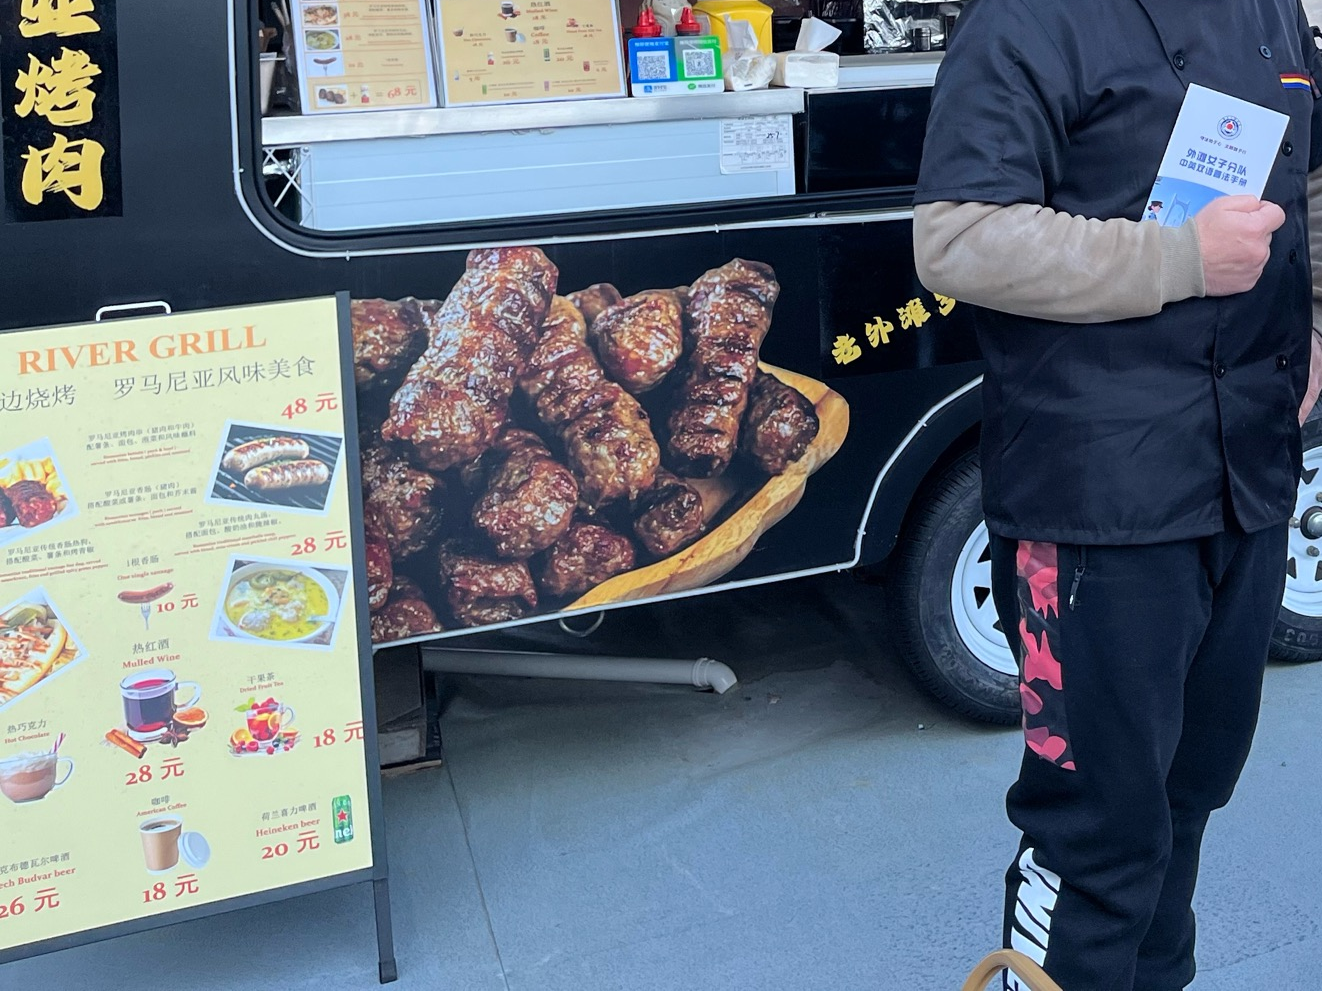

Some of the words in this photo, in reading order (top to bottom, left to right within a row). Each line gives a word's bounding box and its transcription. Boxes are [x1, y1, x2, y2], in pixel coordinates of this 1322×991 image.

[387, 87, 402, 99] 68
[404, 86, 417, 96] 元
[17, 338, 139, 375] RIVER
[149, 325, 267, 360] GRILL
[113, 355, 316, 400] 罗马尼亚风味美食
[281, 397, 308, 420] 48
[315, 391, 338, 412] 元
[291, 536, 317, 556] 28
[324, 530, 347, 551] 元
[157, 603, 175, 613] 10
[180, 594, 199, 610] 元
[132, 638, 169, 654] 热红酒
[122, 657, 154, 669] Mulled
[157, 654, 180, 663] Wine
[313, 728, 336, 748] 18
[344, 721, 365, 742] 元
[125, 765, 152, 785] 28
[160, 757, 184, 780] 元
[262, 802, 317, 821] 荷兰喜力啤酒
[256, 823, 299, 837] Heineken
[301, 819, 320, 827] beer
[261, 843, 288, 859] 20
[297, 830, 320, 853] 元
[18, 873, 52, 885] Budvar
[54, 868, 76, 877] beer
[143, 882, 167, 903] 18
[175, 873, 199, 897] 元
[0, 896, 25, 918] 26
[34, 887, 60, 912] 元
